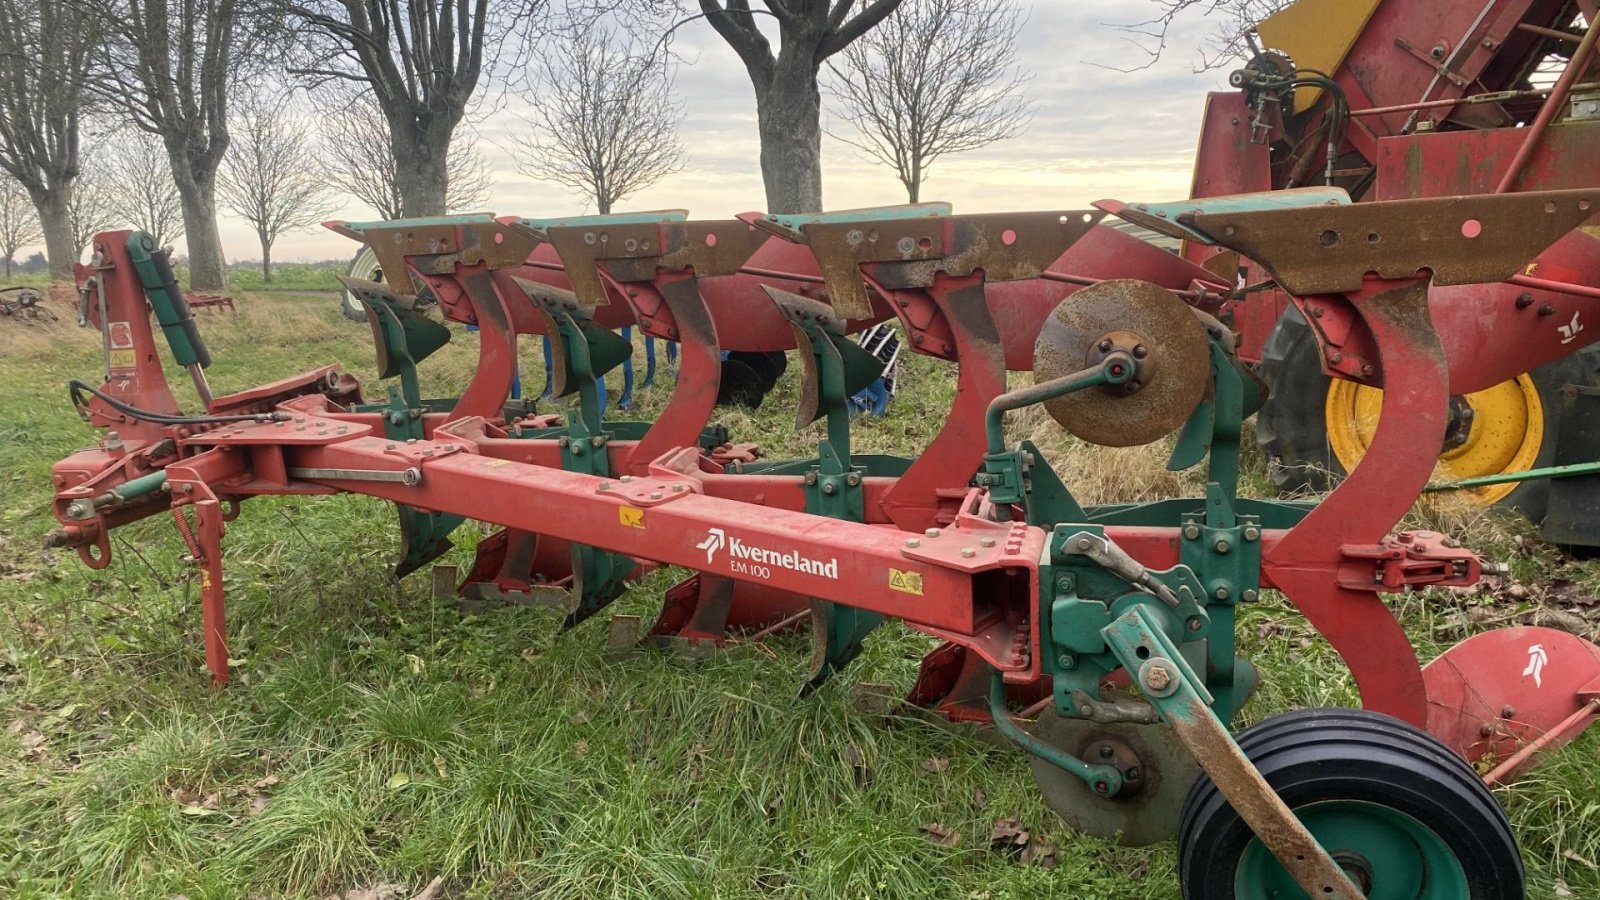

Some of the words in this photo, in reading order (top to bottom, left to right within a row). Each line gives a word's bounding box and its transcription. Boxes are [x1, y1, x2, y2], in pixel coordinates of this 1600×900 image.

[729, 537, 838, 579] Kverneland
[731, 560, 747, 574] EM
[750, 564, 770, 579] 100
